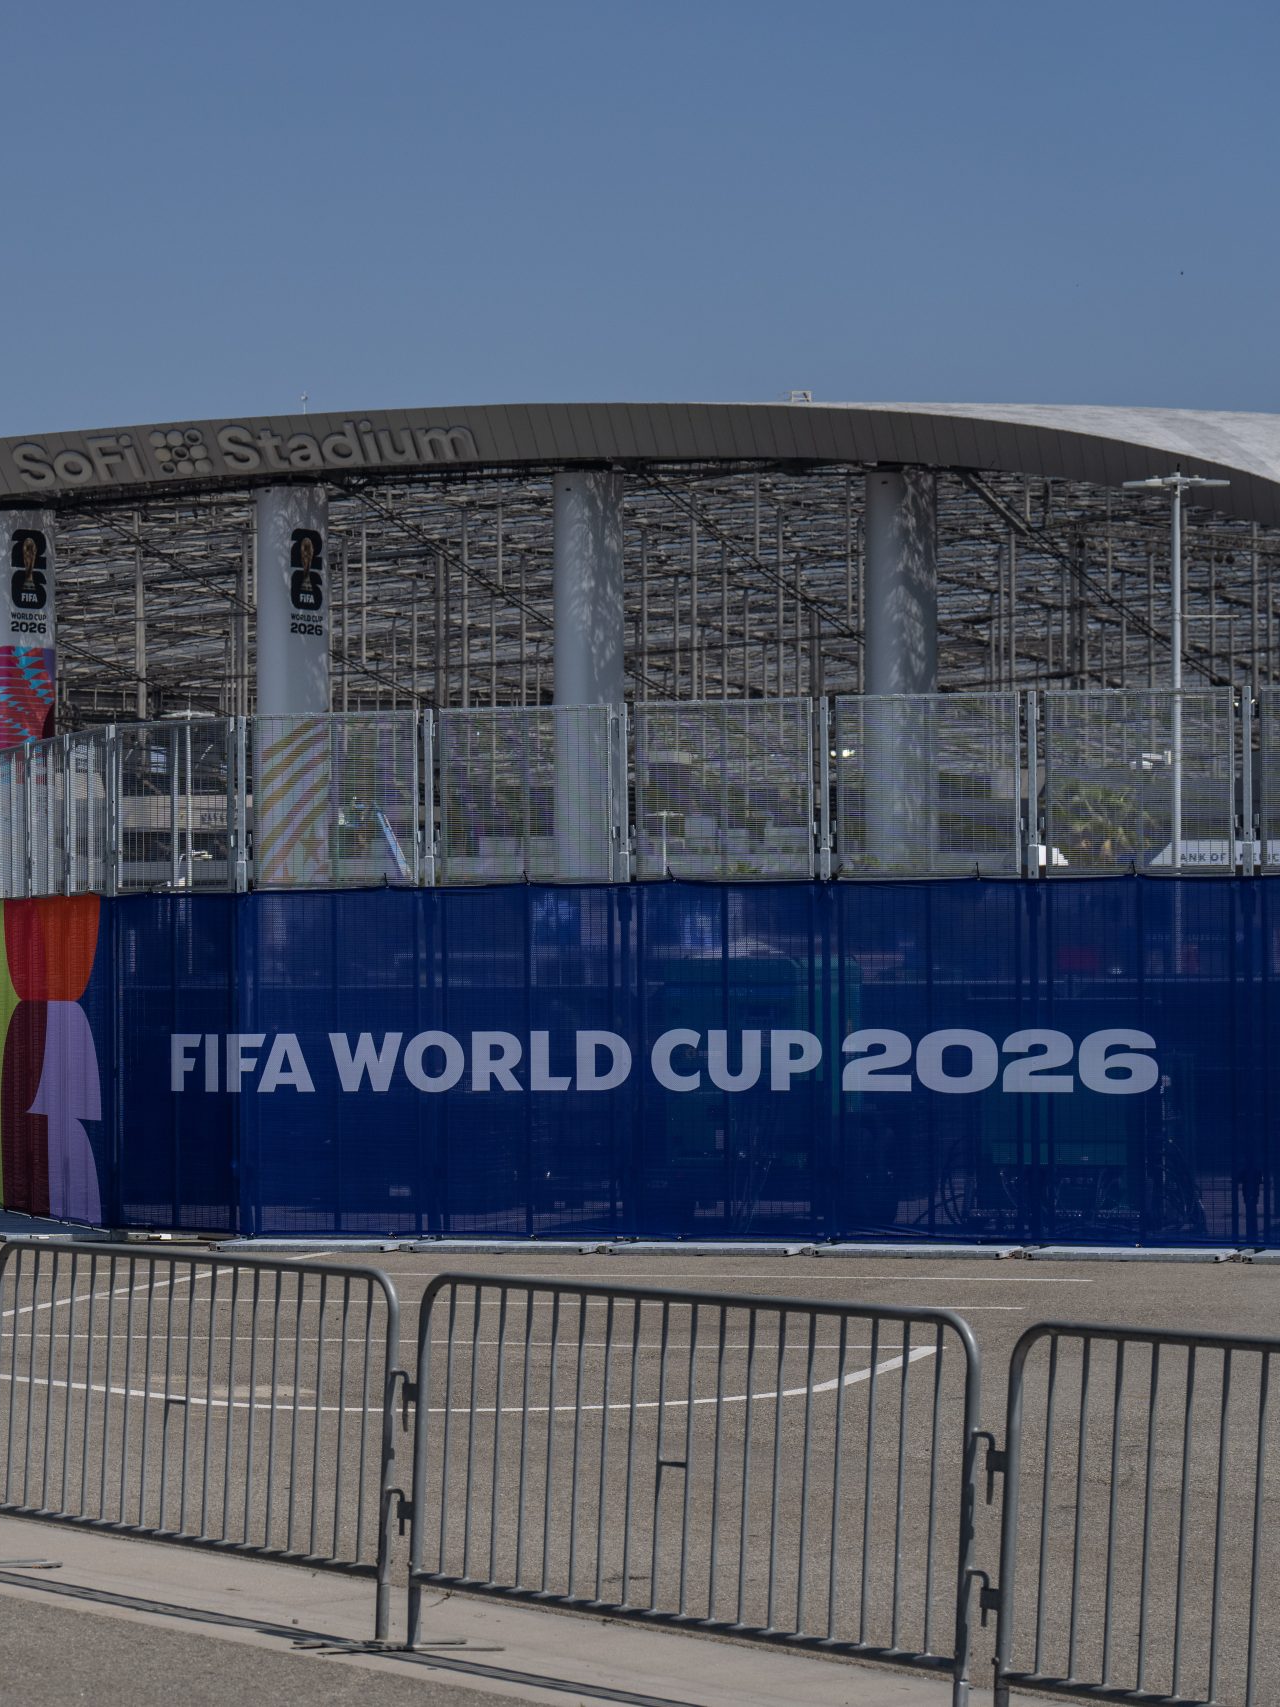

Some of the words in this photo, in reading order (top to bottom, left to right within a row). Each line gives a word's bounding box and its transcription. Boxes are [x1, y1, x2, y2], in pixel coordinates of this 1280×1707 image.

[12, 433, 145, 488] SoFi
[217, 419, 479, 471] Stadium
[21, 593, 38, 602] FIFA
[300, 594, 314, 603] FIFA
[11, 611, 33, 620] WORLD
[34, 613, 46, 621] CUP
[291, 613, 311, 621] WORLD
[11, 620, 46, 633] 2026
[291, 623, 322, 636] 2026
[1175, 853, 1206, 862] ANK
[1211, 853, 1226, 862] OF
[170, 1033, 316, 1093] FIFA
[329, 1030, 632, 1092] WORLD
[651, 1028, 822, 1092] CUP
[841, 1028, 1159, 1094] 2026
